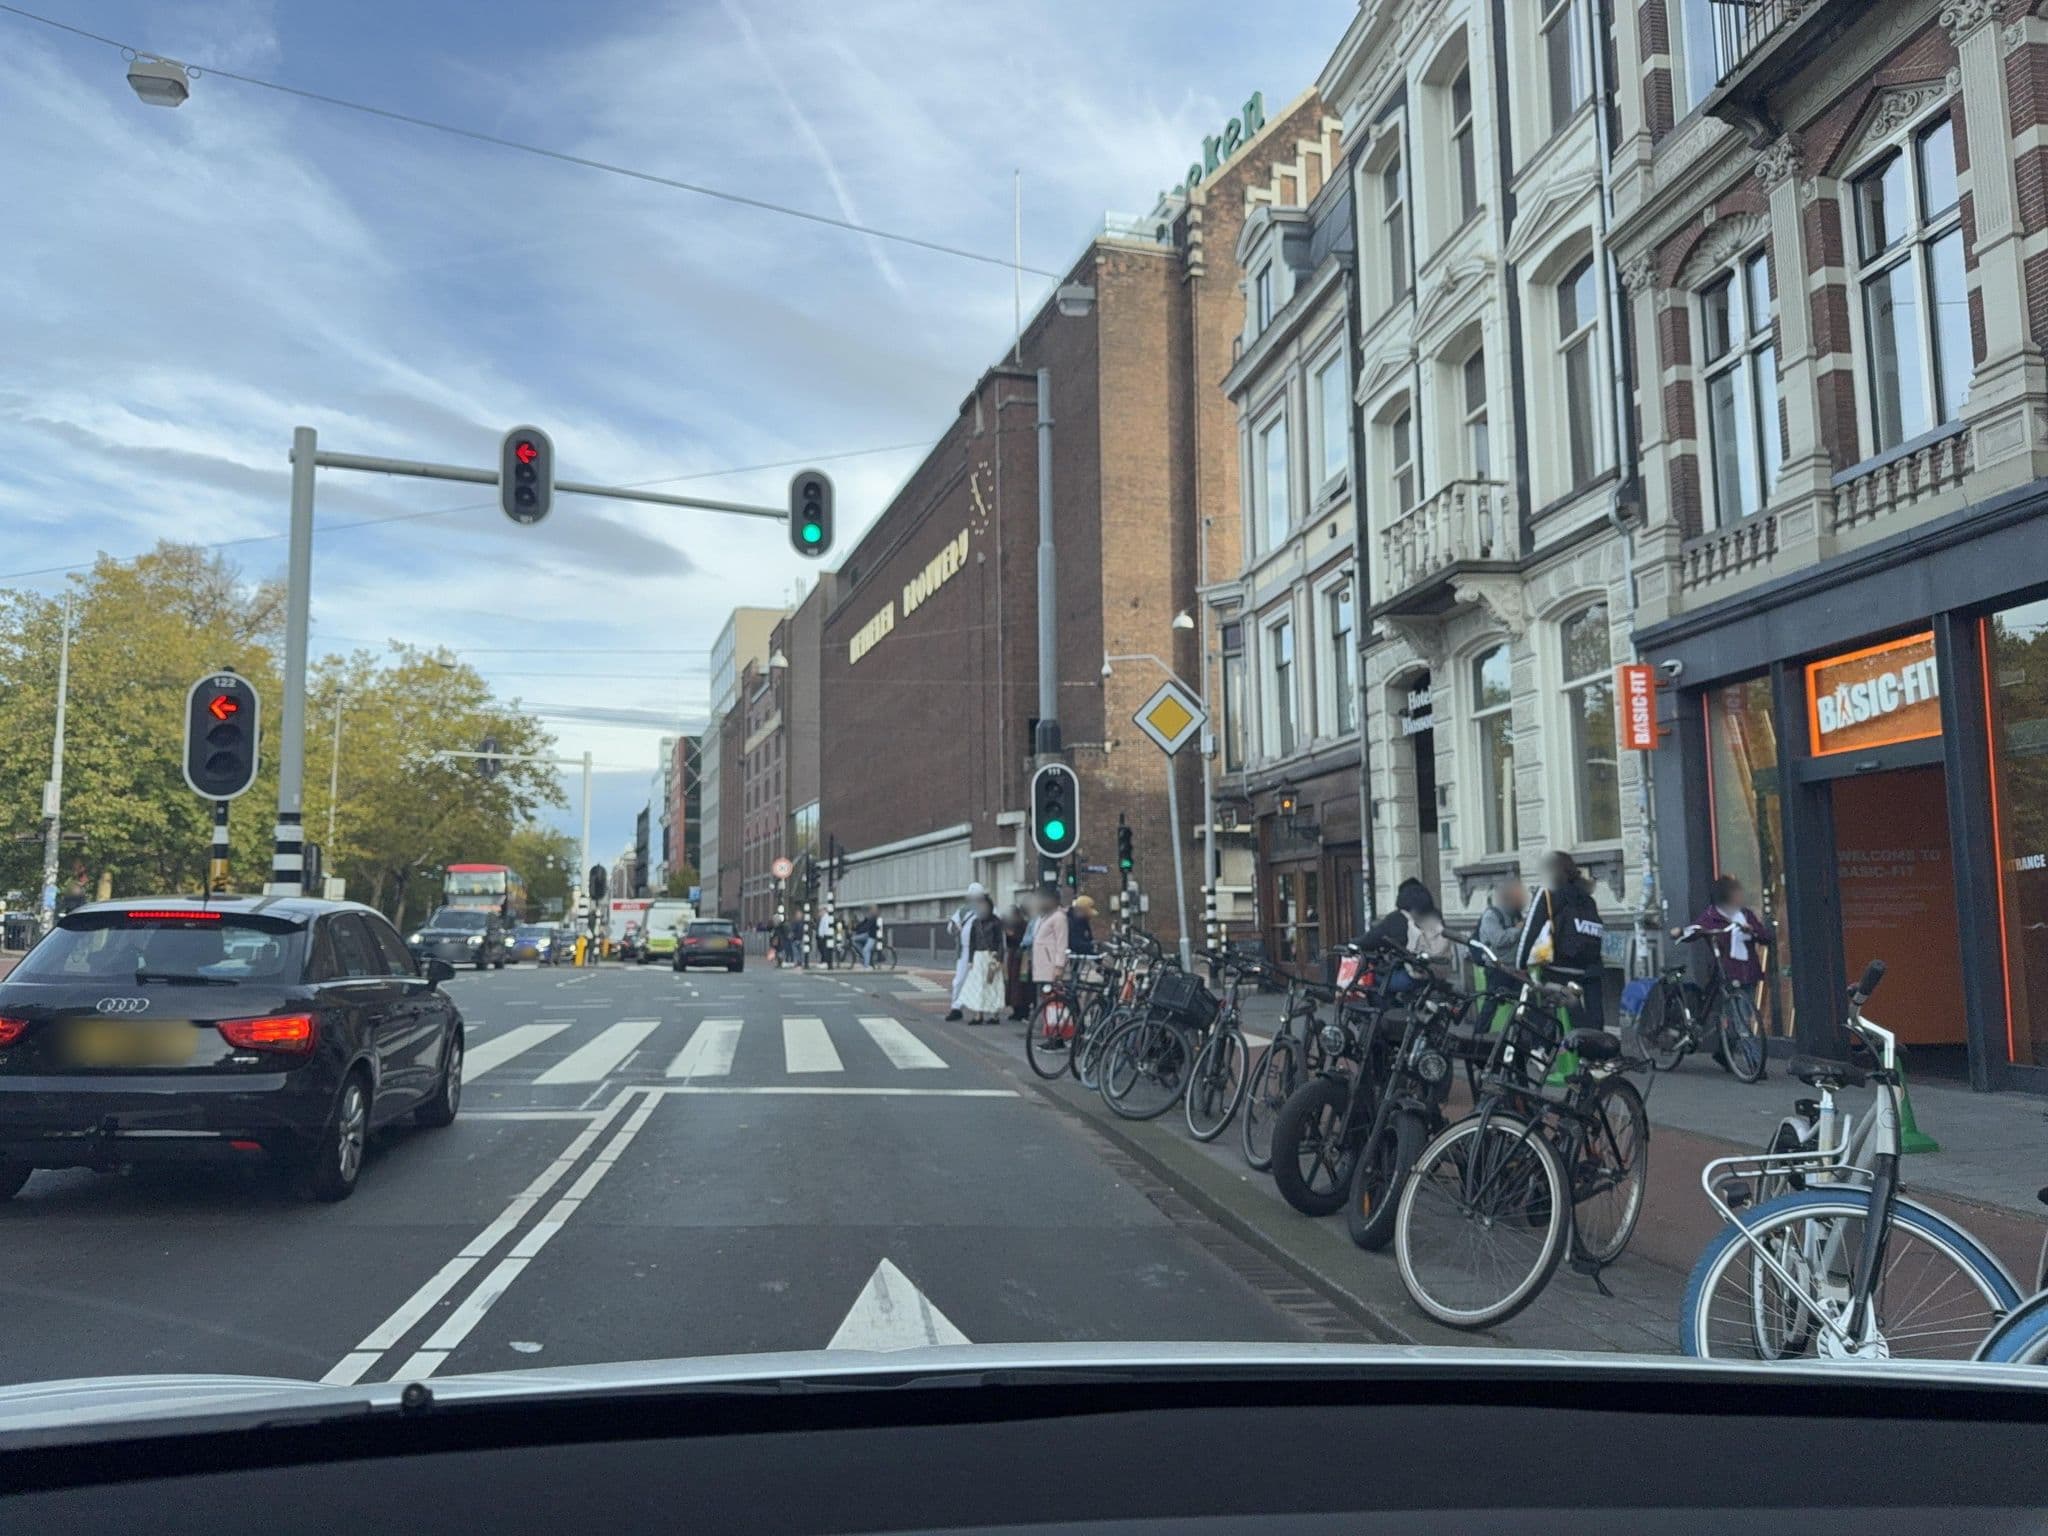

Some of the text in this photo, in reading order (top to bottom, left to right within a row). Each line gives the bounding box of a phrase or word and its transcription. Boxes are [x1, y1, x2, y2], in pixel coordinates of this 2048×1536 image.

[1158, 91, 1265, 196] eken
[214, 677, 238, 688] 122
[1408, 685, 1433, 711] Hotel
[1629, 670, 1651, 745] BASIC-FIT
[1817, 655, 1940, 734] BASIC-FIT
[2006, 854, 2047, 871] TRANCE
